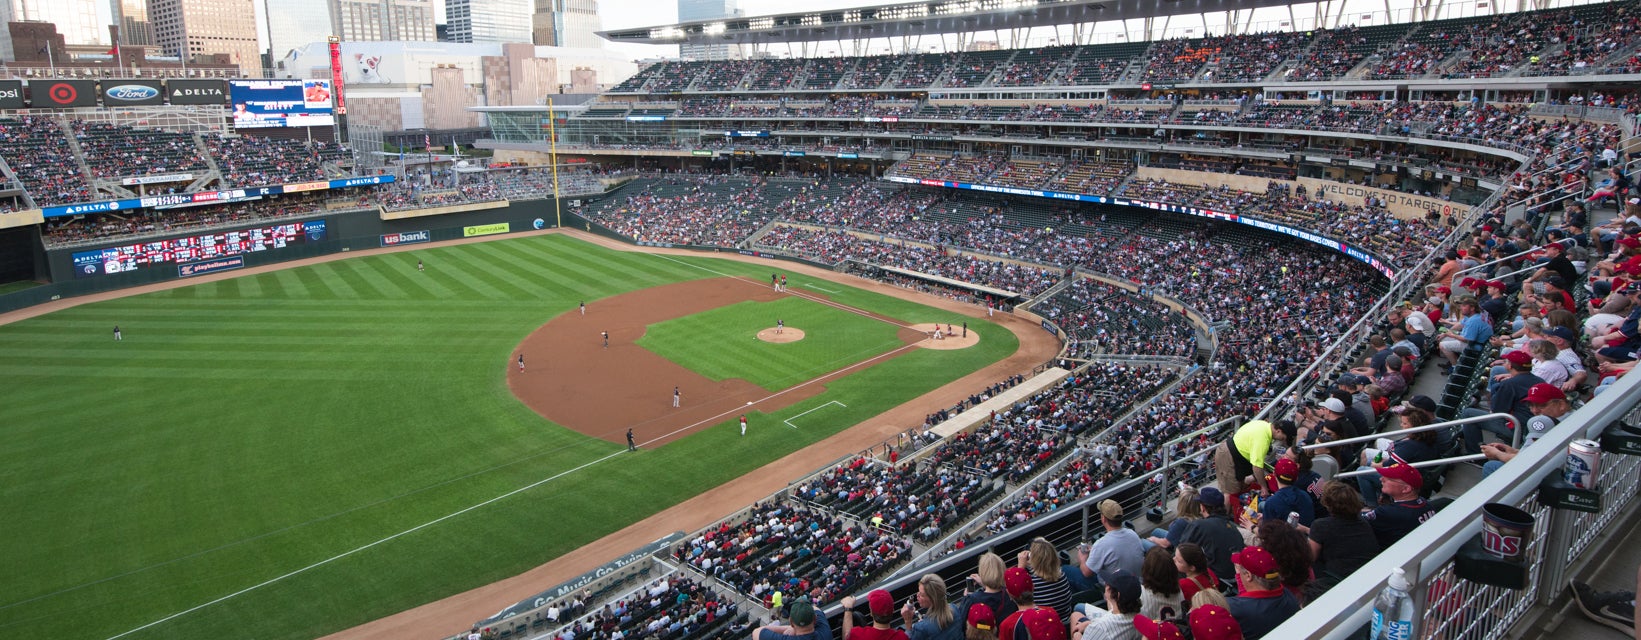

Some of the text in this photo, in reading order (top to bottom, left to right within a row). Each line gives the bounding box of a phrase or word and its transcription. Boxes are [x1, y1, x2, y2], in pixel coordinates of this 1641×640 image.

[116, 87, 148, 98] Ford
[1320, 183, 1379, 199] WELCOME
[1382, 192, 1396, 204] TO
[1400, 197, 1442, 211] TARGET
[75, 204, 106, 212] DELTA
[1351, 250, 1364, 260] DELTA
[1530, 386, 1539, 395] T
[534, 596, 555, 608] Go
[557, 576, 593, 596] Music
[596, 567, 614, 578] Go
